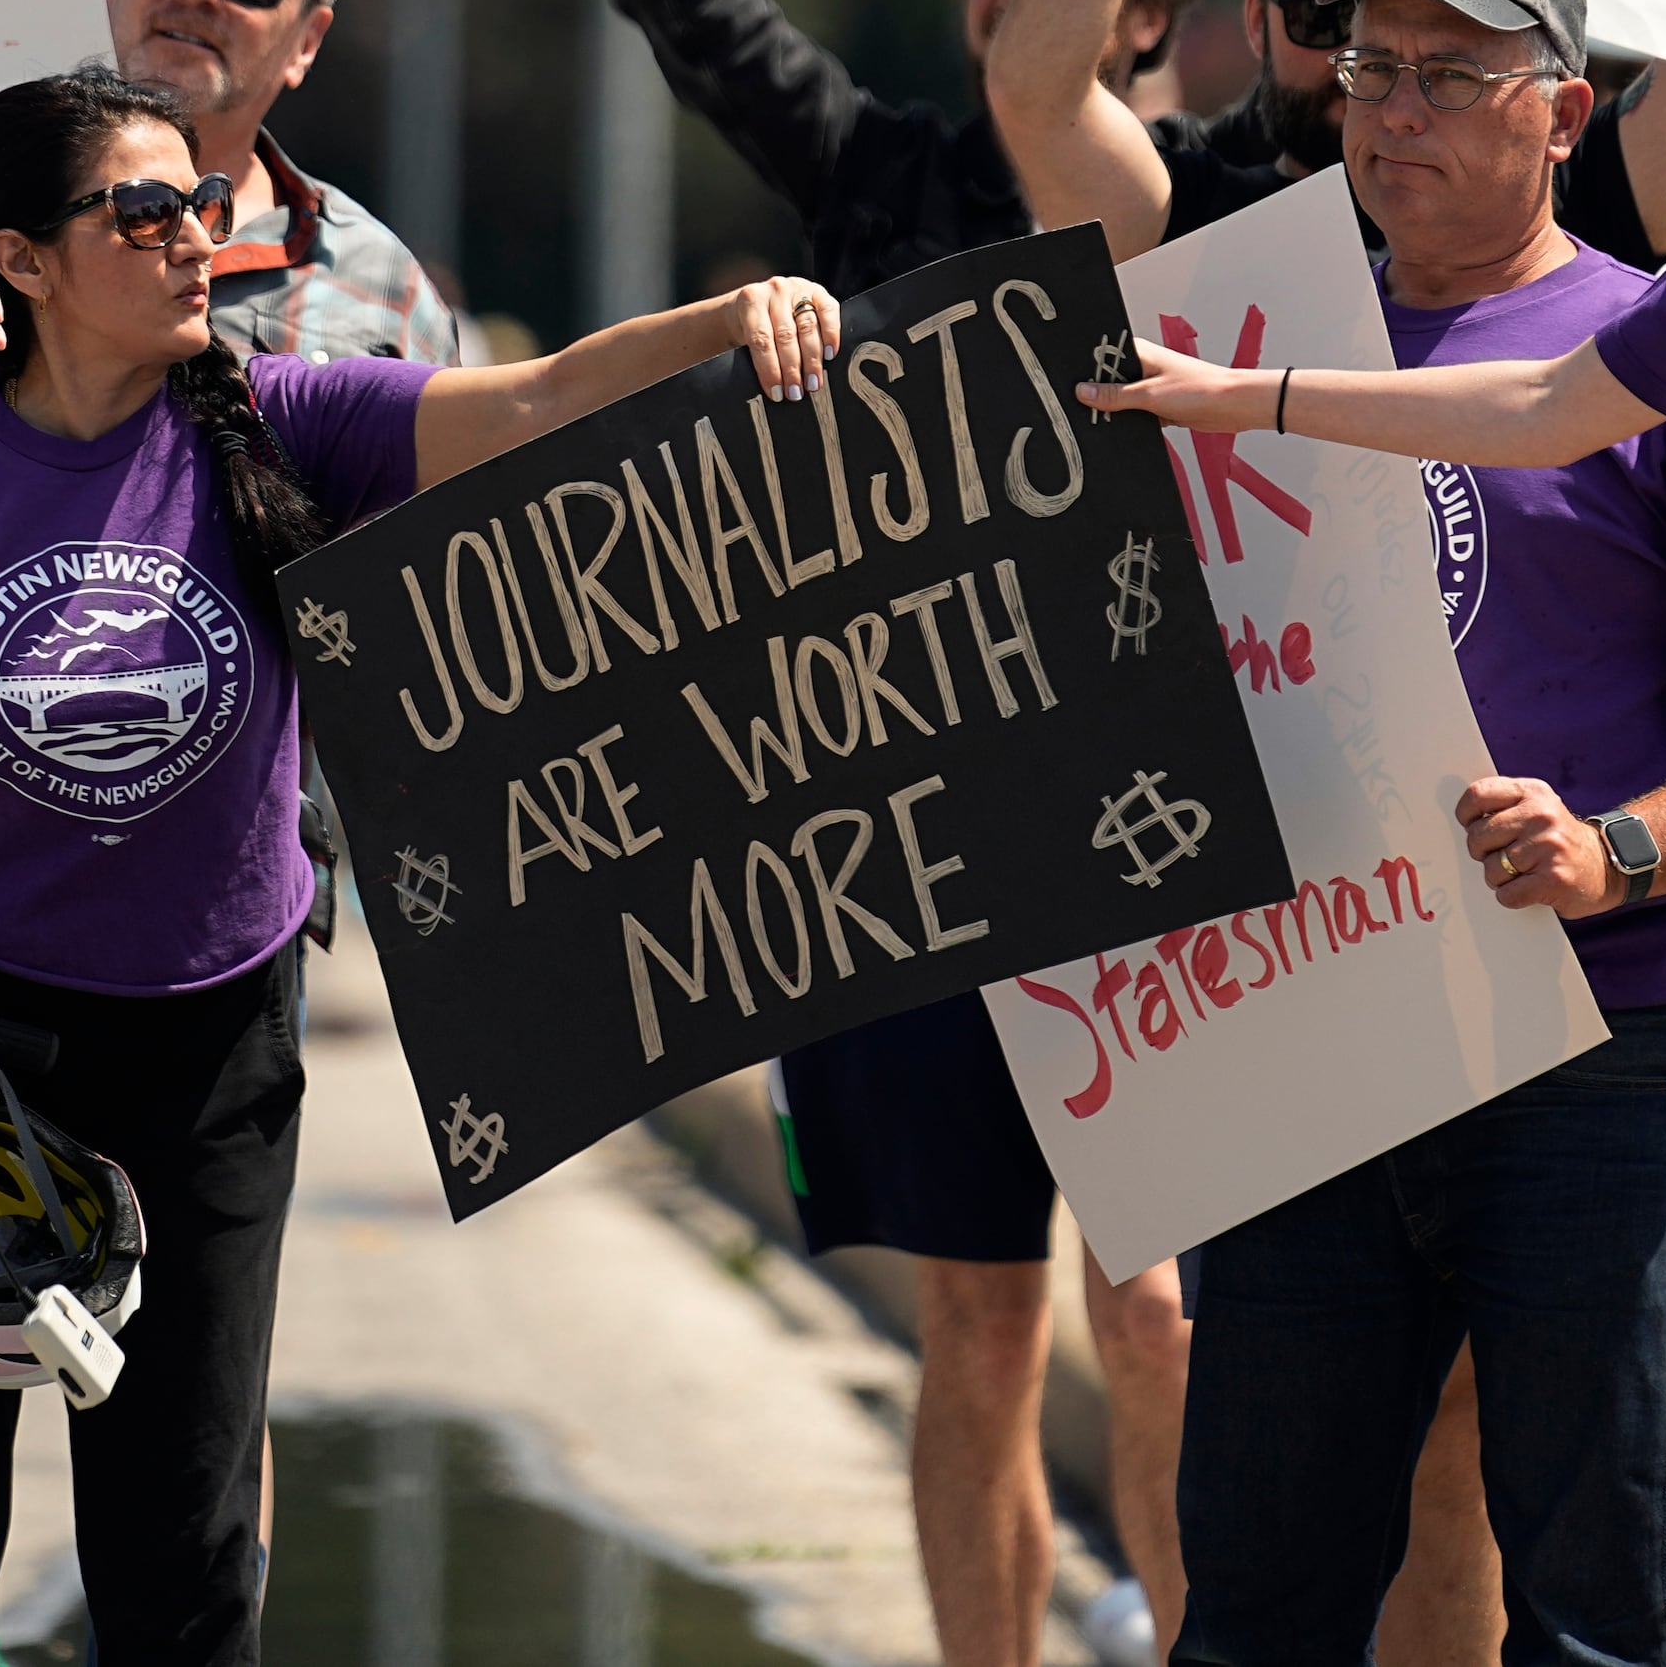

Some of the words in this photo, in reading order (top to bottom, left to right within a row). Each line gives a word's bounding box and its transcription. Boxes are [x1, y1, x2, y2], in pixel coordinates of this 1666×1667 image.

[52, 550, 240, 655] NEWSGUILD
[397, 278, 1084, 754] JOURNALISTS
[11, 760, 46, 785] OF
[46, 772, 93, 804] THE
[507, 724, 664, 907] ARE
[680, 558, 1061, 806] WORTH
[620, 772, 992, 1066] MORE
